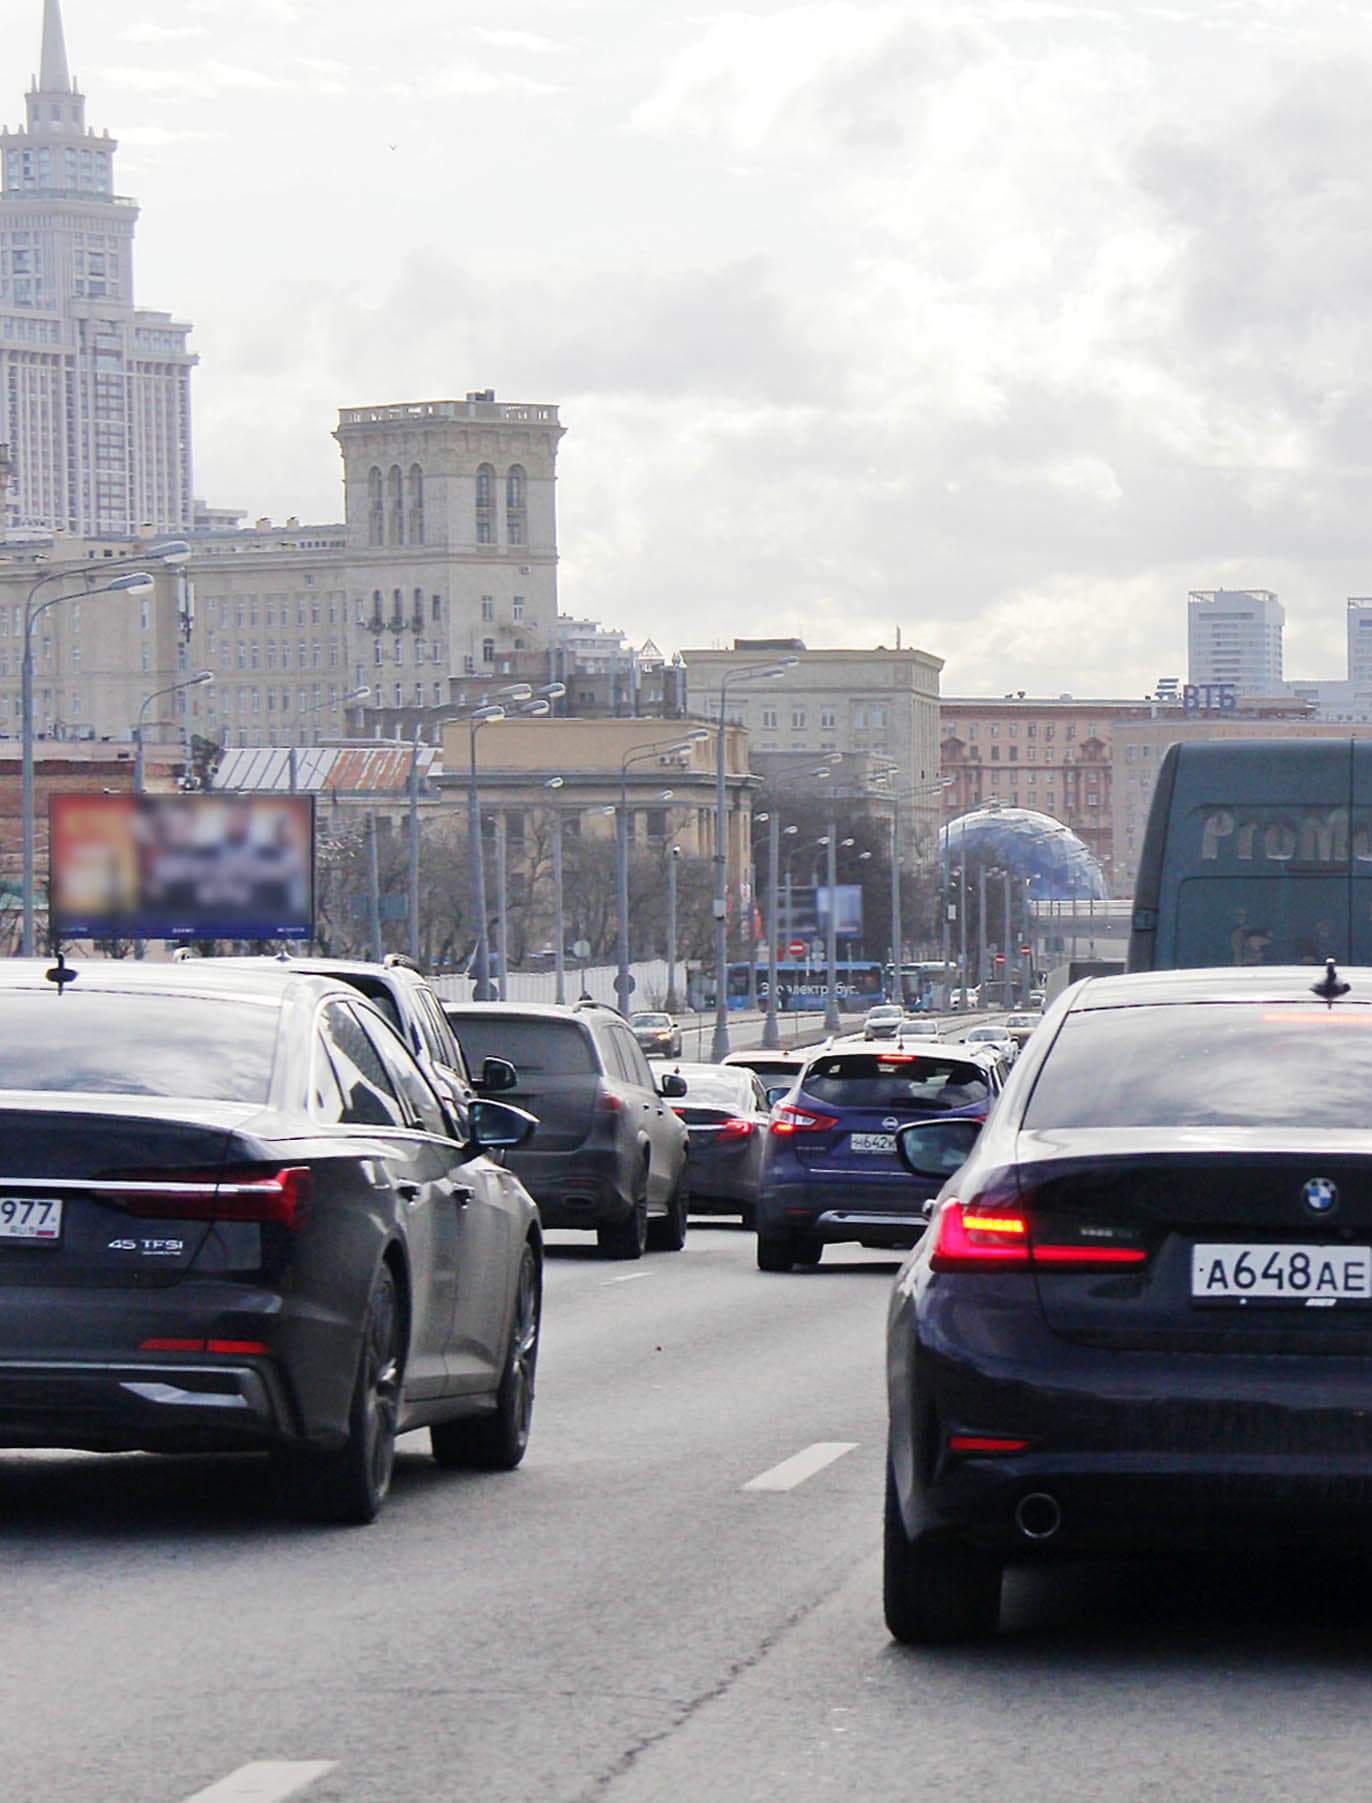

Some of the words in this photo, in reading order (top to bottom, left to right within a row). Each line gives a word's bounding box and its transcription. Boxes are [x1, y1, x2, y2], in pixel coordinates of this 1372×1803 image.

[1184, 684, 1236, 712] ВТБ
[1, 1200, 54, 1225] 977
[141, 1239, 185, 1250] TFSI
[1206, 1250, 1366, 1292] А648АЕ
